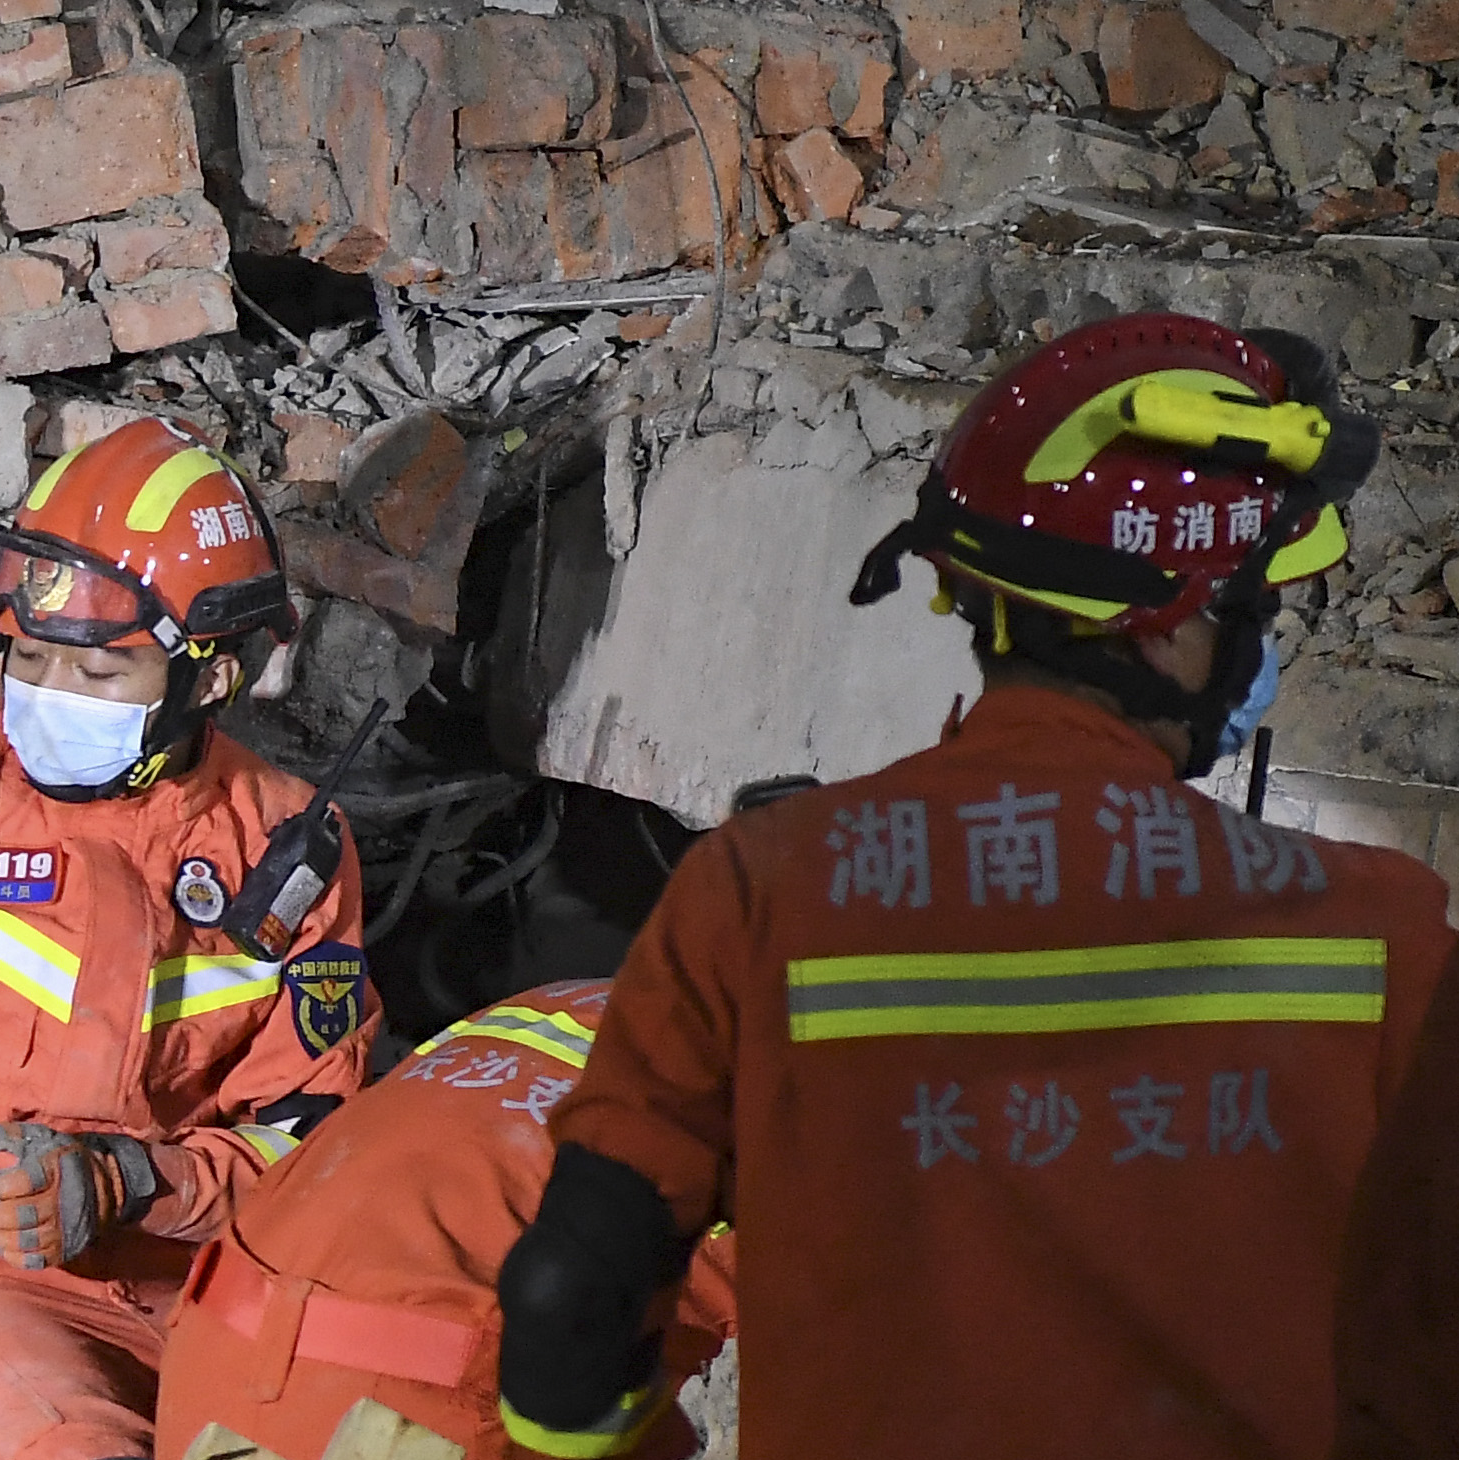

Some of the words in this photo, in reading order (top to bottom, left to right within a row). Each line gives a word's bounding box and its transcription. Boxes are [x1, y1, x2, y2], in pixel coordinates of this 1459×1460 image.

[190, 500, 264, 550] 湖南
[824, 782, 1328, 908] 湖南消防
[901, 1068, 1283, 1169] 长沙支队
